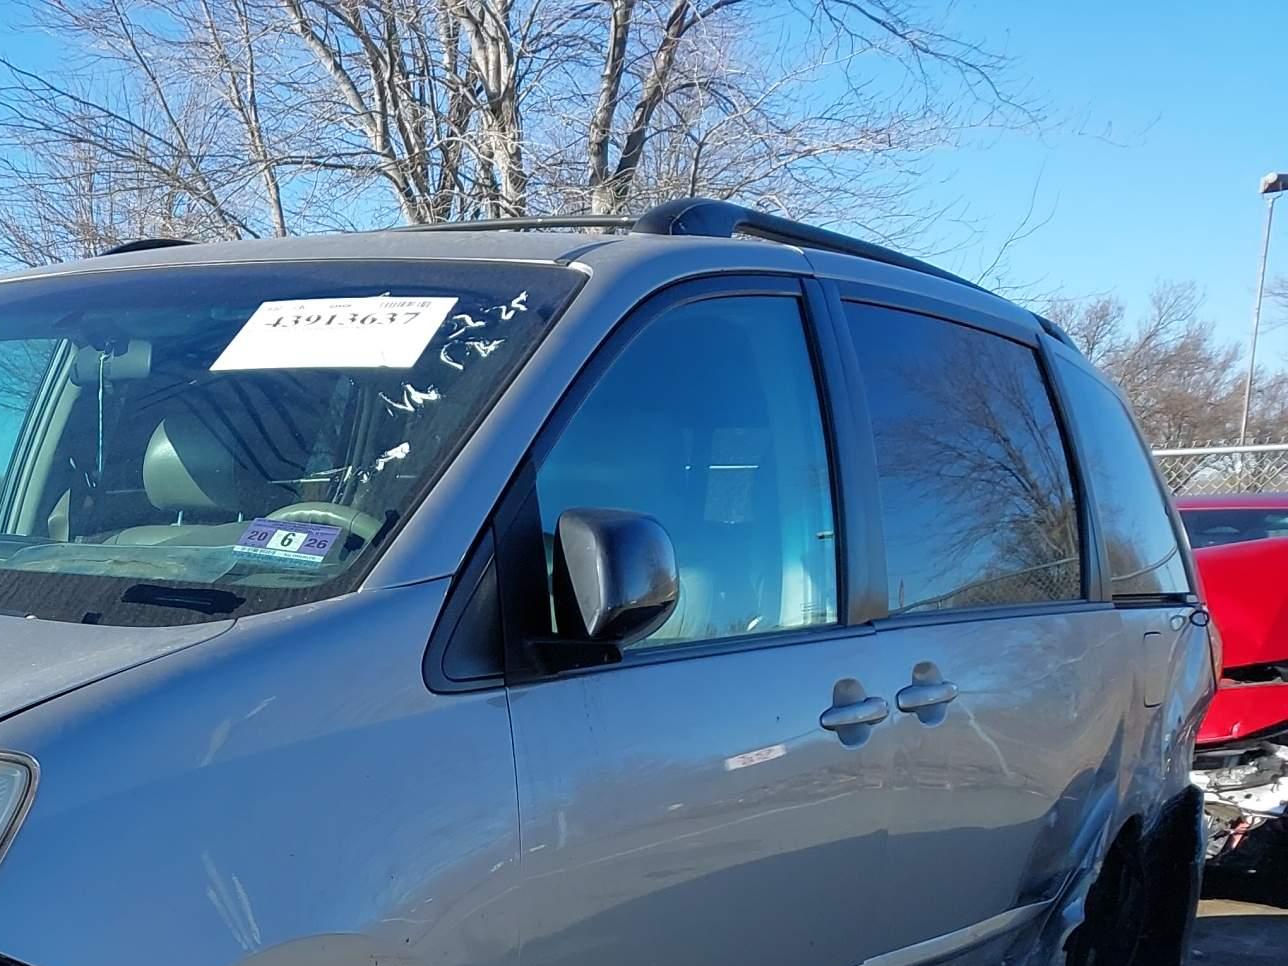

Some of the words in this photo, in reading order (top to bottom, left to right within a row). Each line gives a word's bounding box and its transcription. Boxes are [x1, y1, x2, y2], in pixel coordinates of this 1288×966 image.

[264, 311, 421, 328] 43913637
[247, 529, 269, 542] 20
[280, 532, 296, 547] 6
[304, 537, 329, 550] 26
